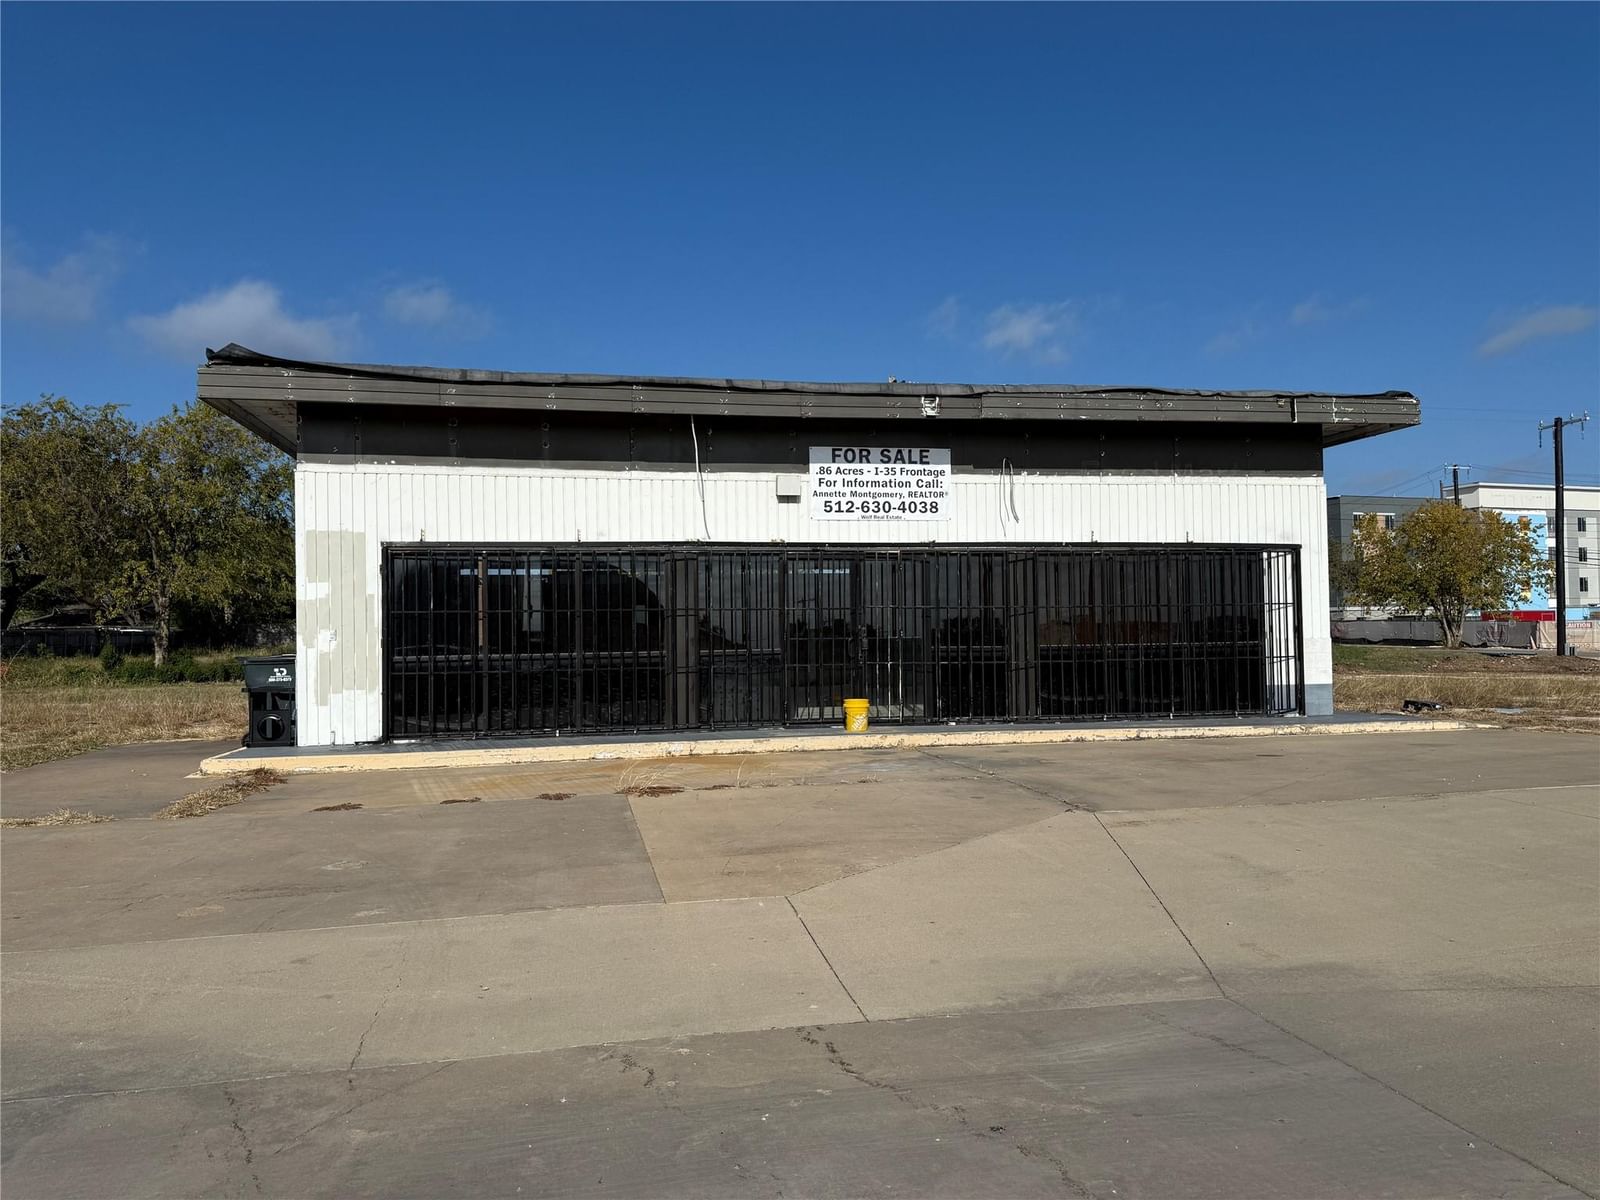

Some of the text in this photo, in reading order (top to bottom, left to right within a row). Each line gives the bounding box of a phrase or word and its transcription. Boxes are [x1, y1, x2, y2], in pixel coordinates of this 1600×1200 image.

[831, 448, 930, 465] FOR SALE
[815, 466, 833, 475] .86
[835, 466, 864, 475] Acres
[874, 467, 897, 476] I-35
[899, 466, 946, 478] Frontage
[818, 477, 943, 489] For Information Call:
[812, 490, 847, 498] Annette
[850, 490, 905, 500] Montgomery,
[823, 500, 939, 514] 512-630-4038
